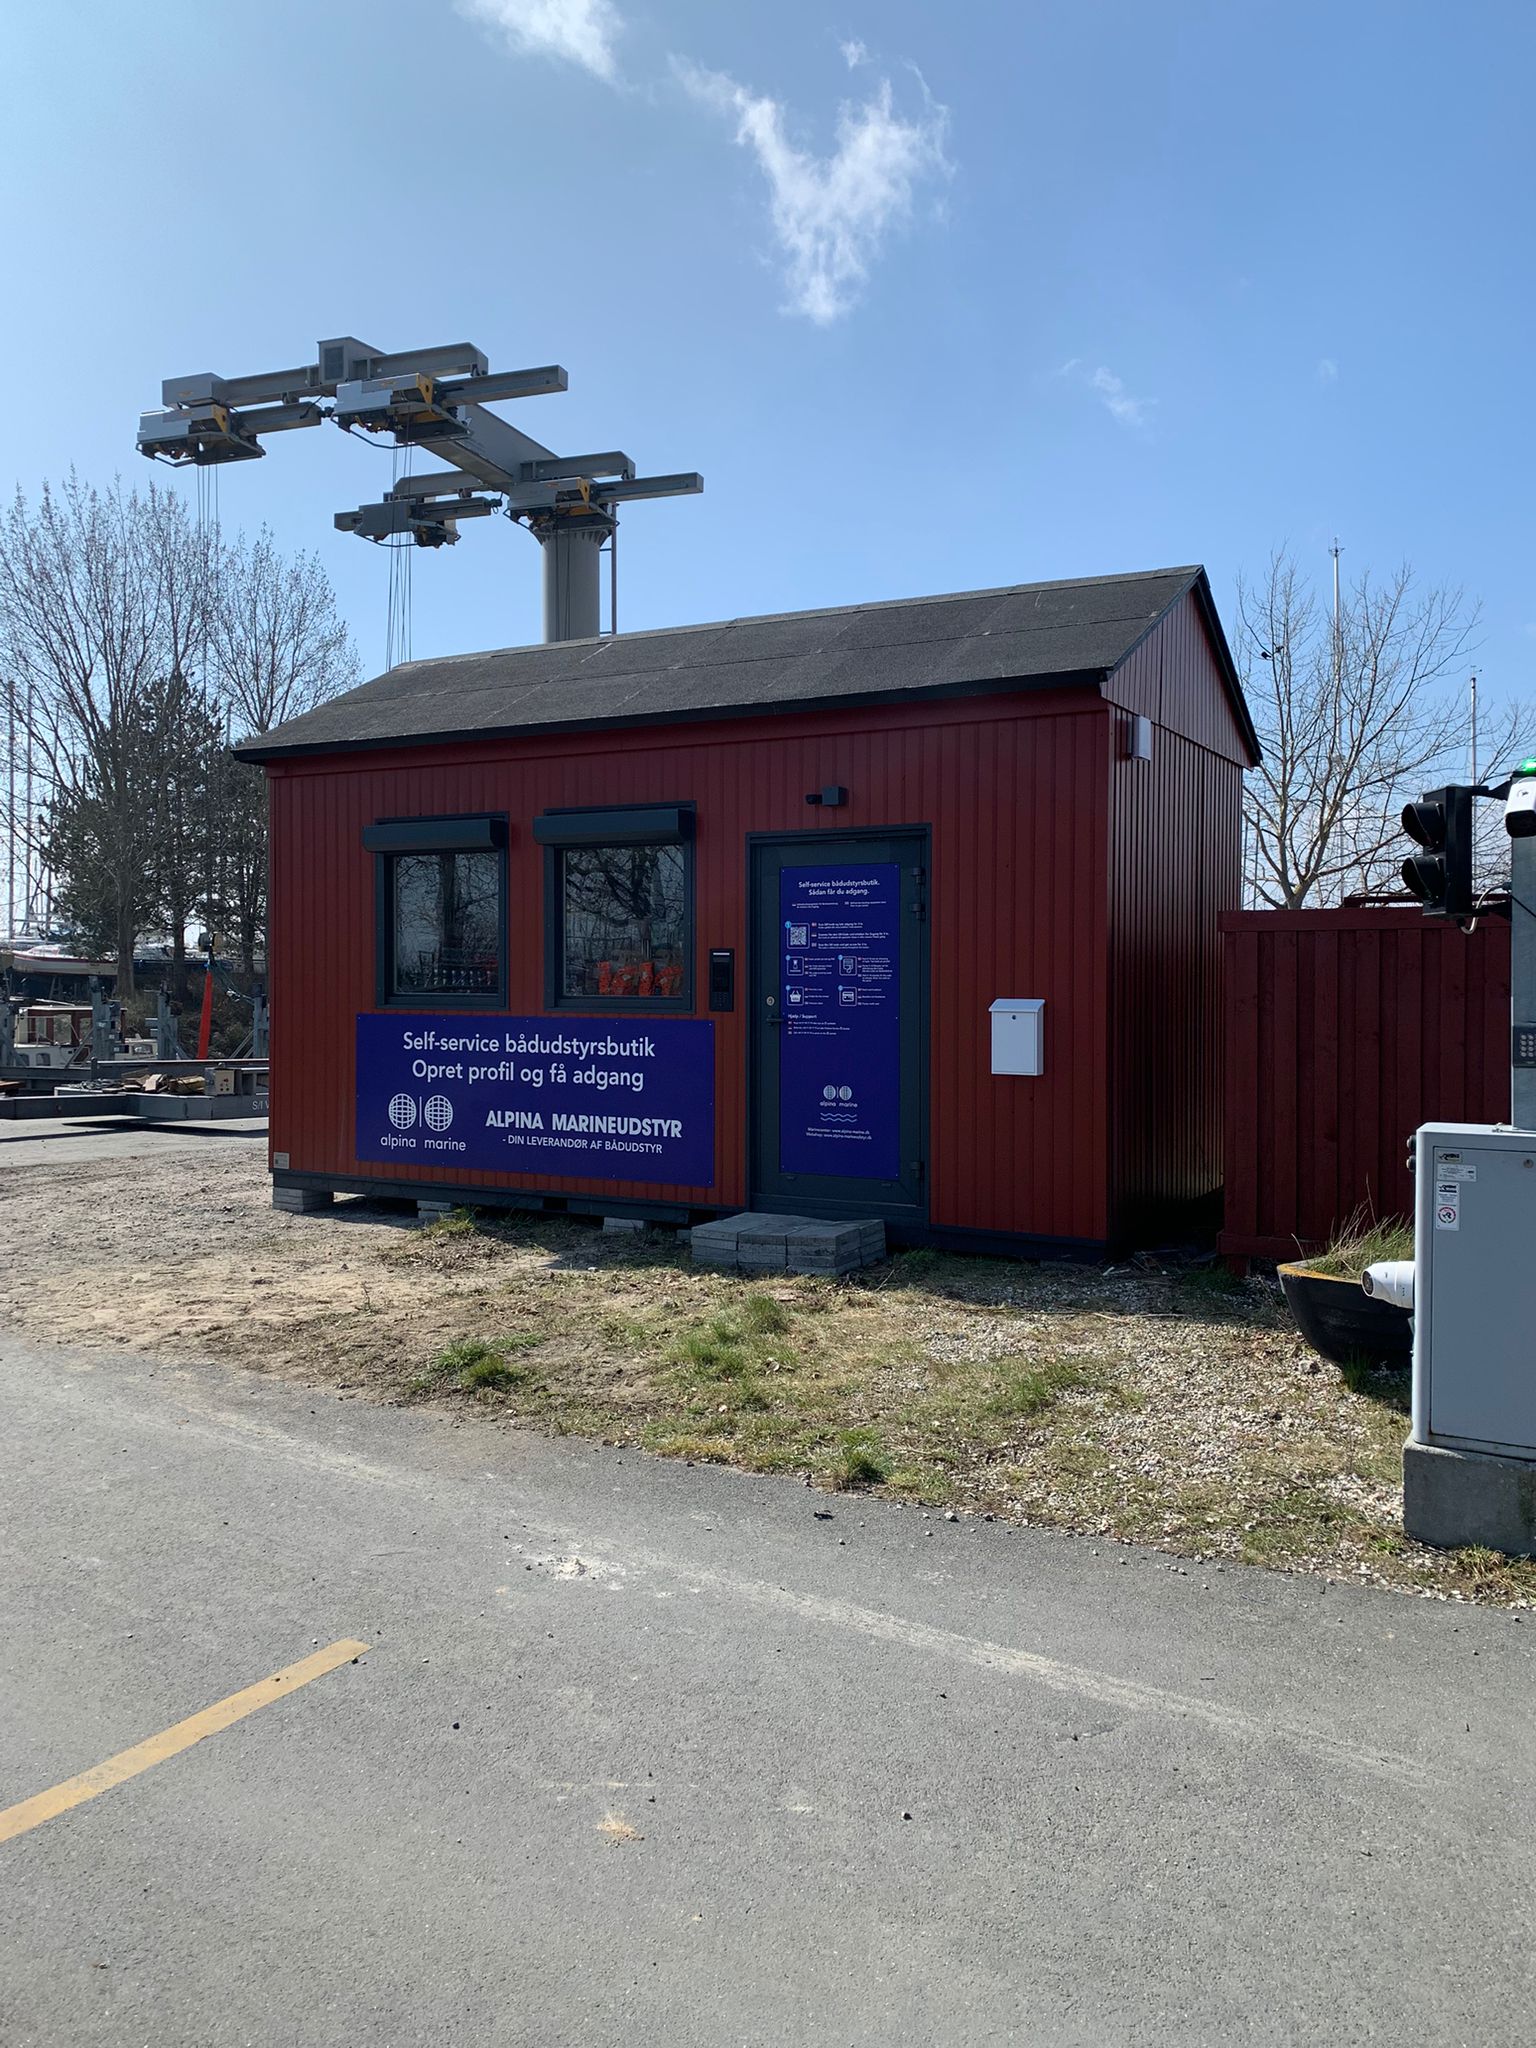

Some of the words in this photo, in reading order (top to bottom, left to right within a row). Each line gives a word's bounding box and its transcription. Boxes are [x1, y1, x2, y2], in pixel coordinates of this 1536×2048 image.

[798, 881, 831, 889] Self-service
[808, 888, 827, 896] Sådan
[836, 887, 845, 895] du
[403, 1031, 500, 1053] Self-service
[505, 1032, 656, 1061] bådudstyrsbutik
[412, 1059, 464, 1083] Opret
[468, 1060, 514, 1085] profil
[520, 1068, 544, 1088] og
[549, 1062, 567, 1083] få
[572, 1064, 644, 1092] adgang
[485, 1110, 545, 1130] ALPINA
[552, 1113, 683, 1138] MARINEUDSTYR
[380, 1133, 417, 1150] alpina
[424, 1137, 467, 1151] marine
[507, 1134, 525, 1145] DIN
[526, 1135, 588, 1149] LEVERANDØR
[589, 1140, 603, 1150] AF
[604, 1138, 663, 1154] BÅDUDSTYR
